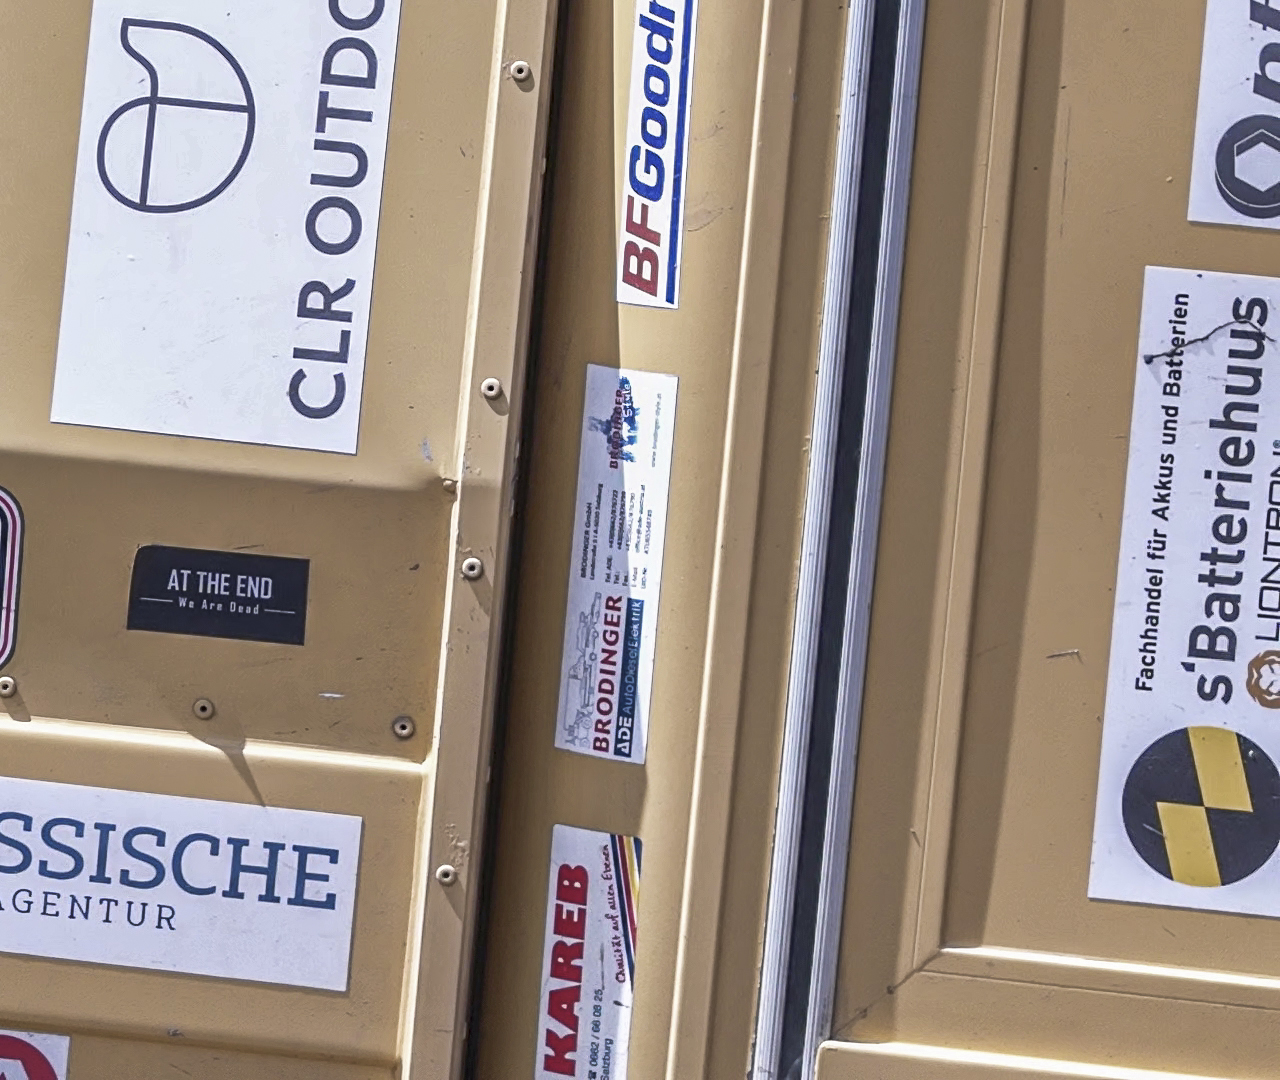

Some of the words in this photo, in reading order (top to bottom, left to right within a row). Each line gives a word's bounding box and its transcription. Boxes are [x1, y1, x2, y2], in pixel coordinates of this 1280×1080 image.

[288, 274, 358, 421] CLR
[1163, 293, 1189, 398] Batterien
[1161, 404, 1179, 445] und
[1153, 452, 1175, 523] Akkus
[167, 569, 191, 592] AT
[196, 571, 230, 595] THE
[236, 575, 272, 599] END
[1147, 533, 1168, 564] für
[178, 596, 194, 608] We
[201, 599, 223, 611] Are
[230, 601, 259, 614] Dead
[1134, 565, 1164, 692] Fachhandel
[593, 596, 623, 753] BRODINGER
[617, 716, 632, 755] ADE
[544, 864, 588, 1076] KAREB
